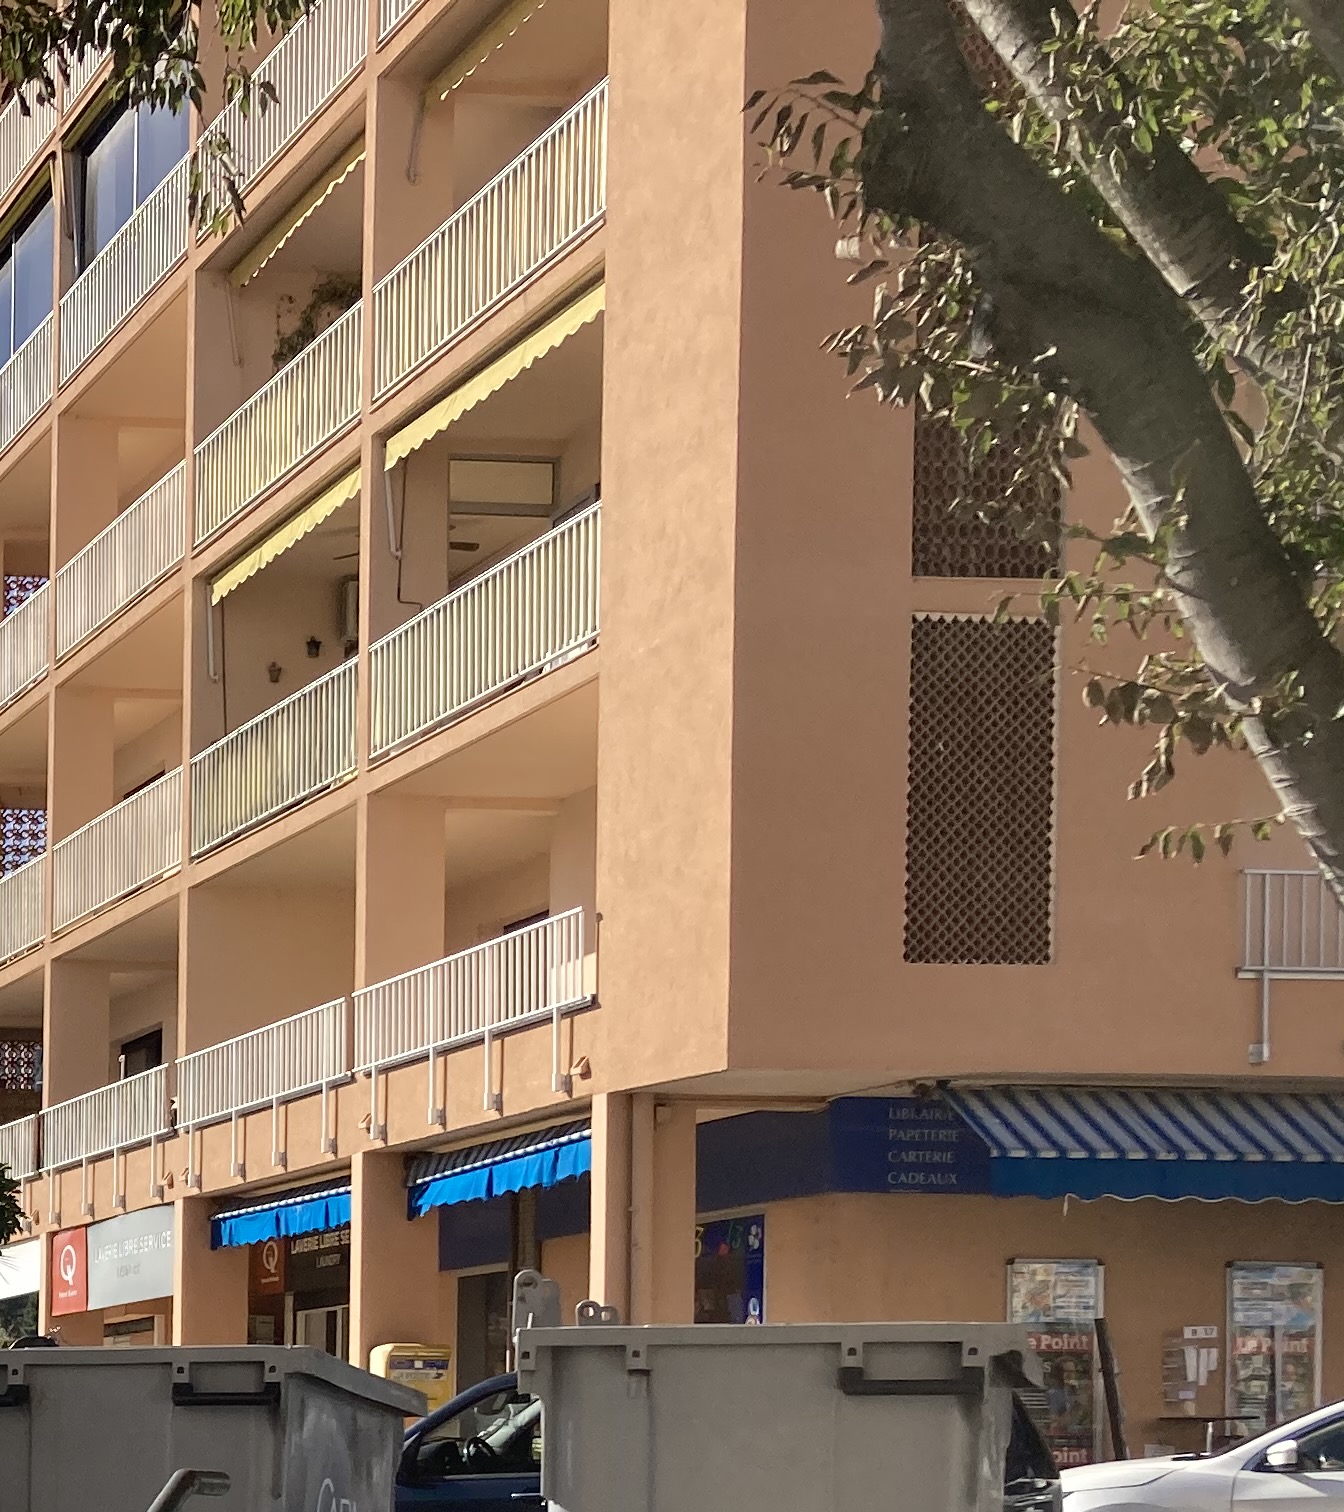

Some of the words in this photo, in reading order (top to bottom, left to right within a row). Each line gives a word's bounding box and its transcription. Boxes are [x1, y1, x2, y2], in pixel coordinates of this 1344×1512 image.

[888, 1128, 959, 1142] PAPETERIE
[887, 1151, 955, 1163] CARTERIE
[887, 1172, 958, 1185] CADEAUX
[139, 1230, 172, 1253] SERVICE
[60, 1244, 77, 1286] Q
[1040, 1333, 1089, 1350] Point
[1053, 1449, 1088, 1464] oint
